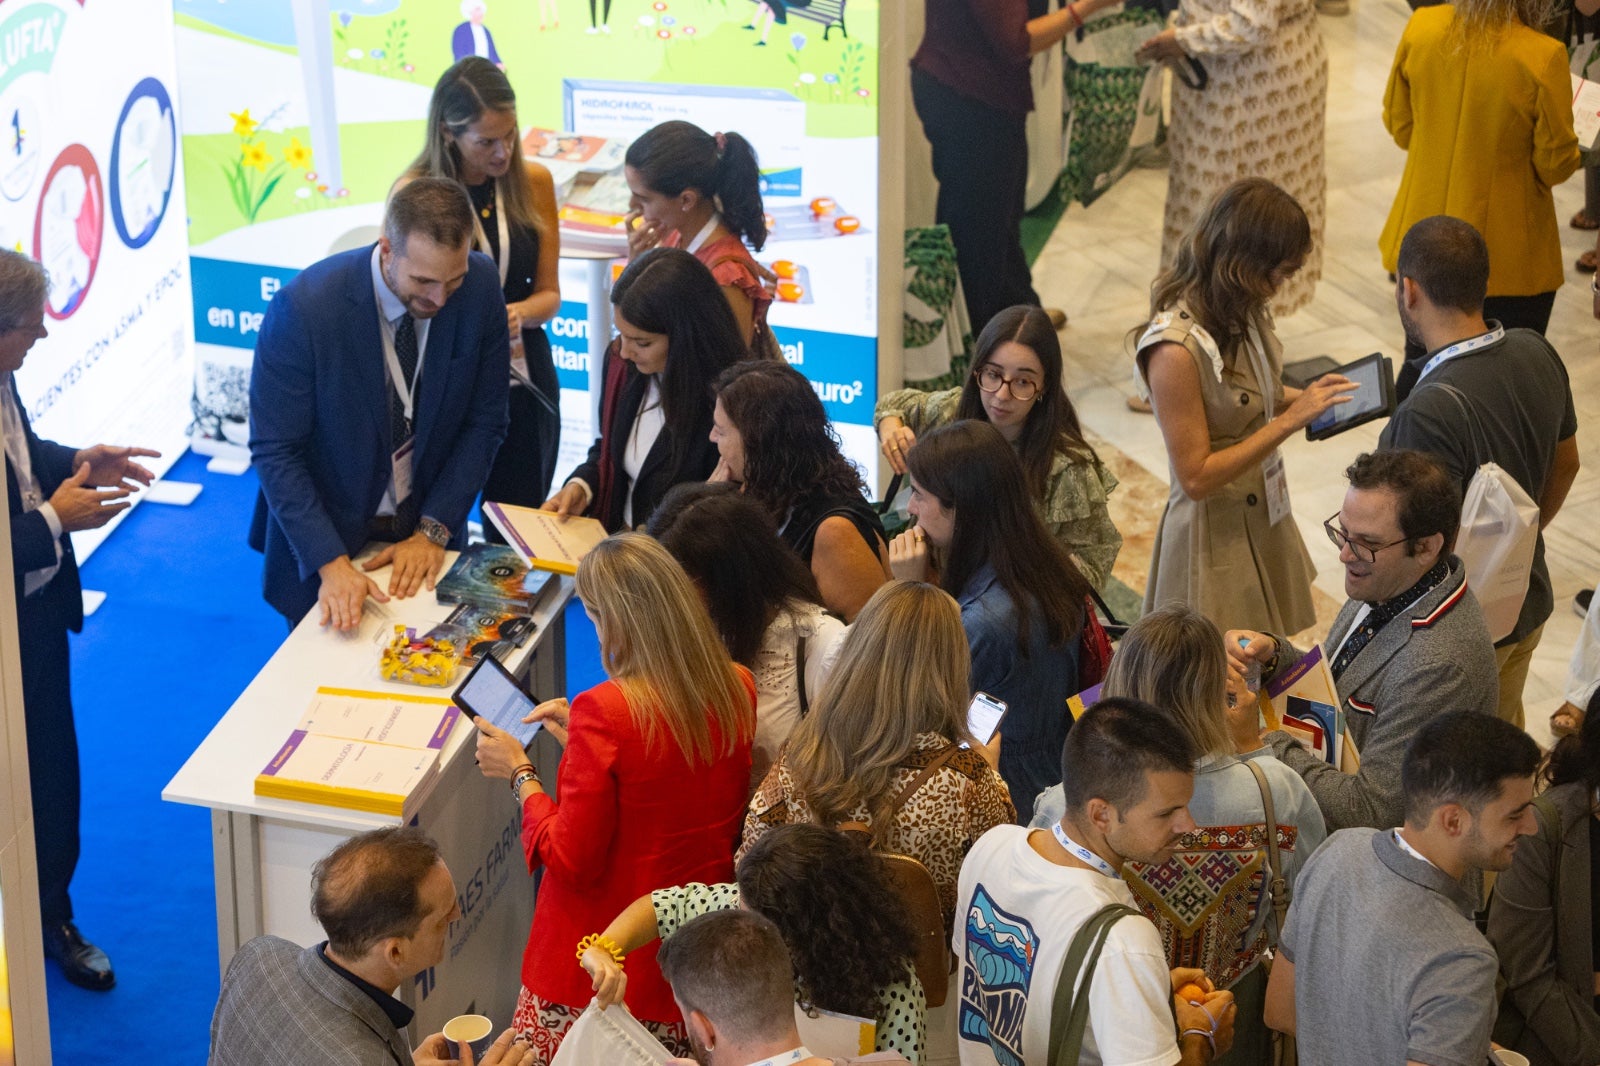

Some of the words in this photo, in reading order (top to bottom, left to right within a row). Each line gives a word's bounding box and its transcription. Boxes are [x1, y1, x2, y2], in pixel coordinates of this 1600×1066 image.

[207, 307, 235, 329] en
[551, 316, 590, 339] con
[85, 338, 110, 369] CON
[113, 303, 143, 340] ASMA
